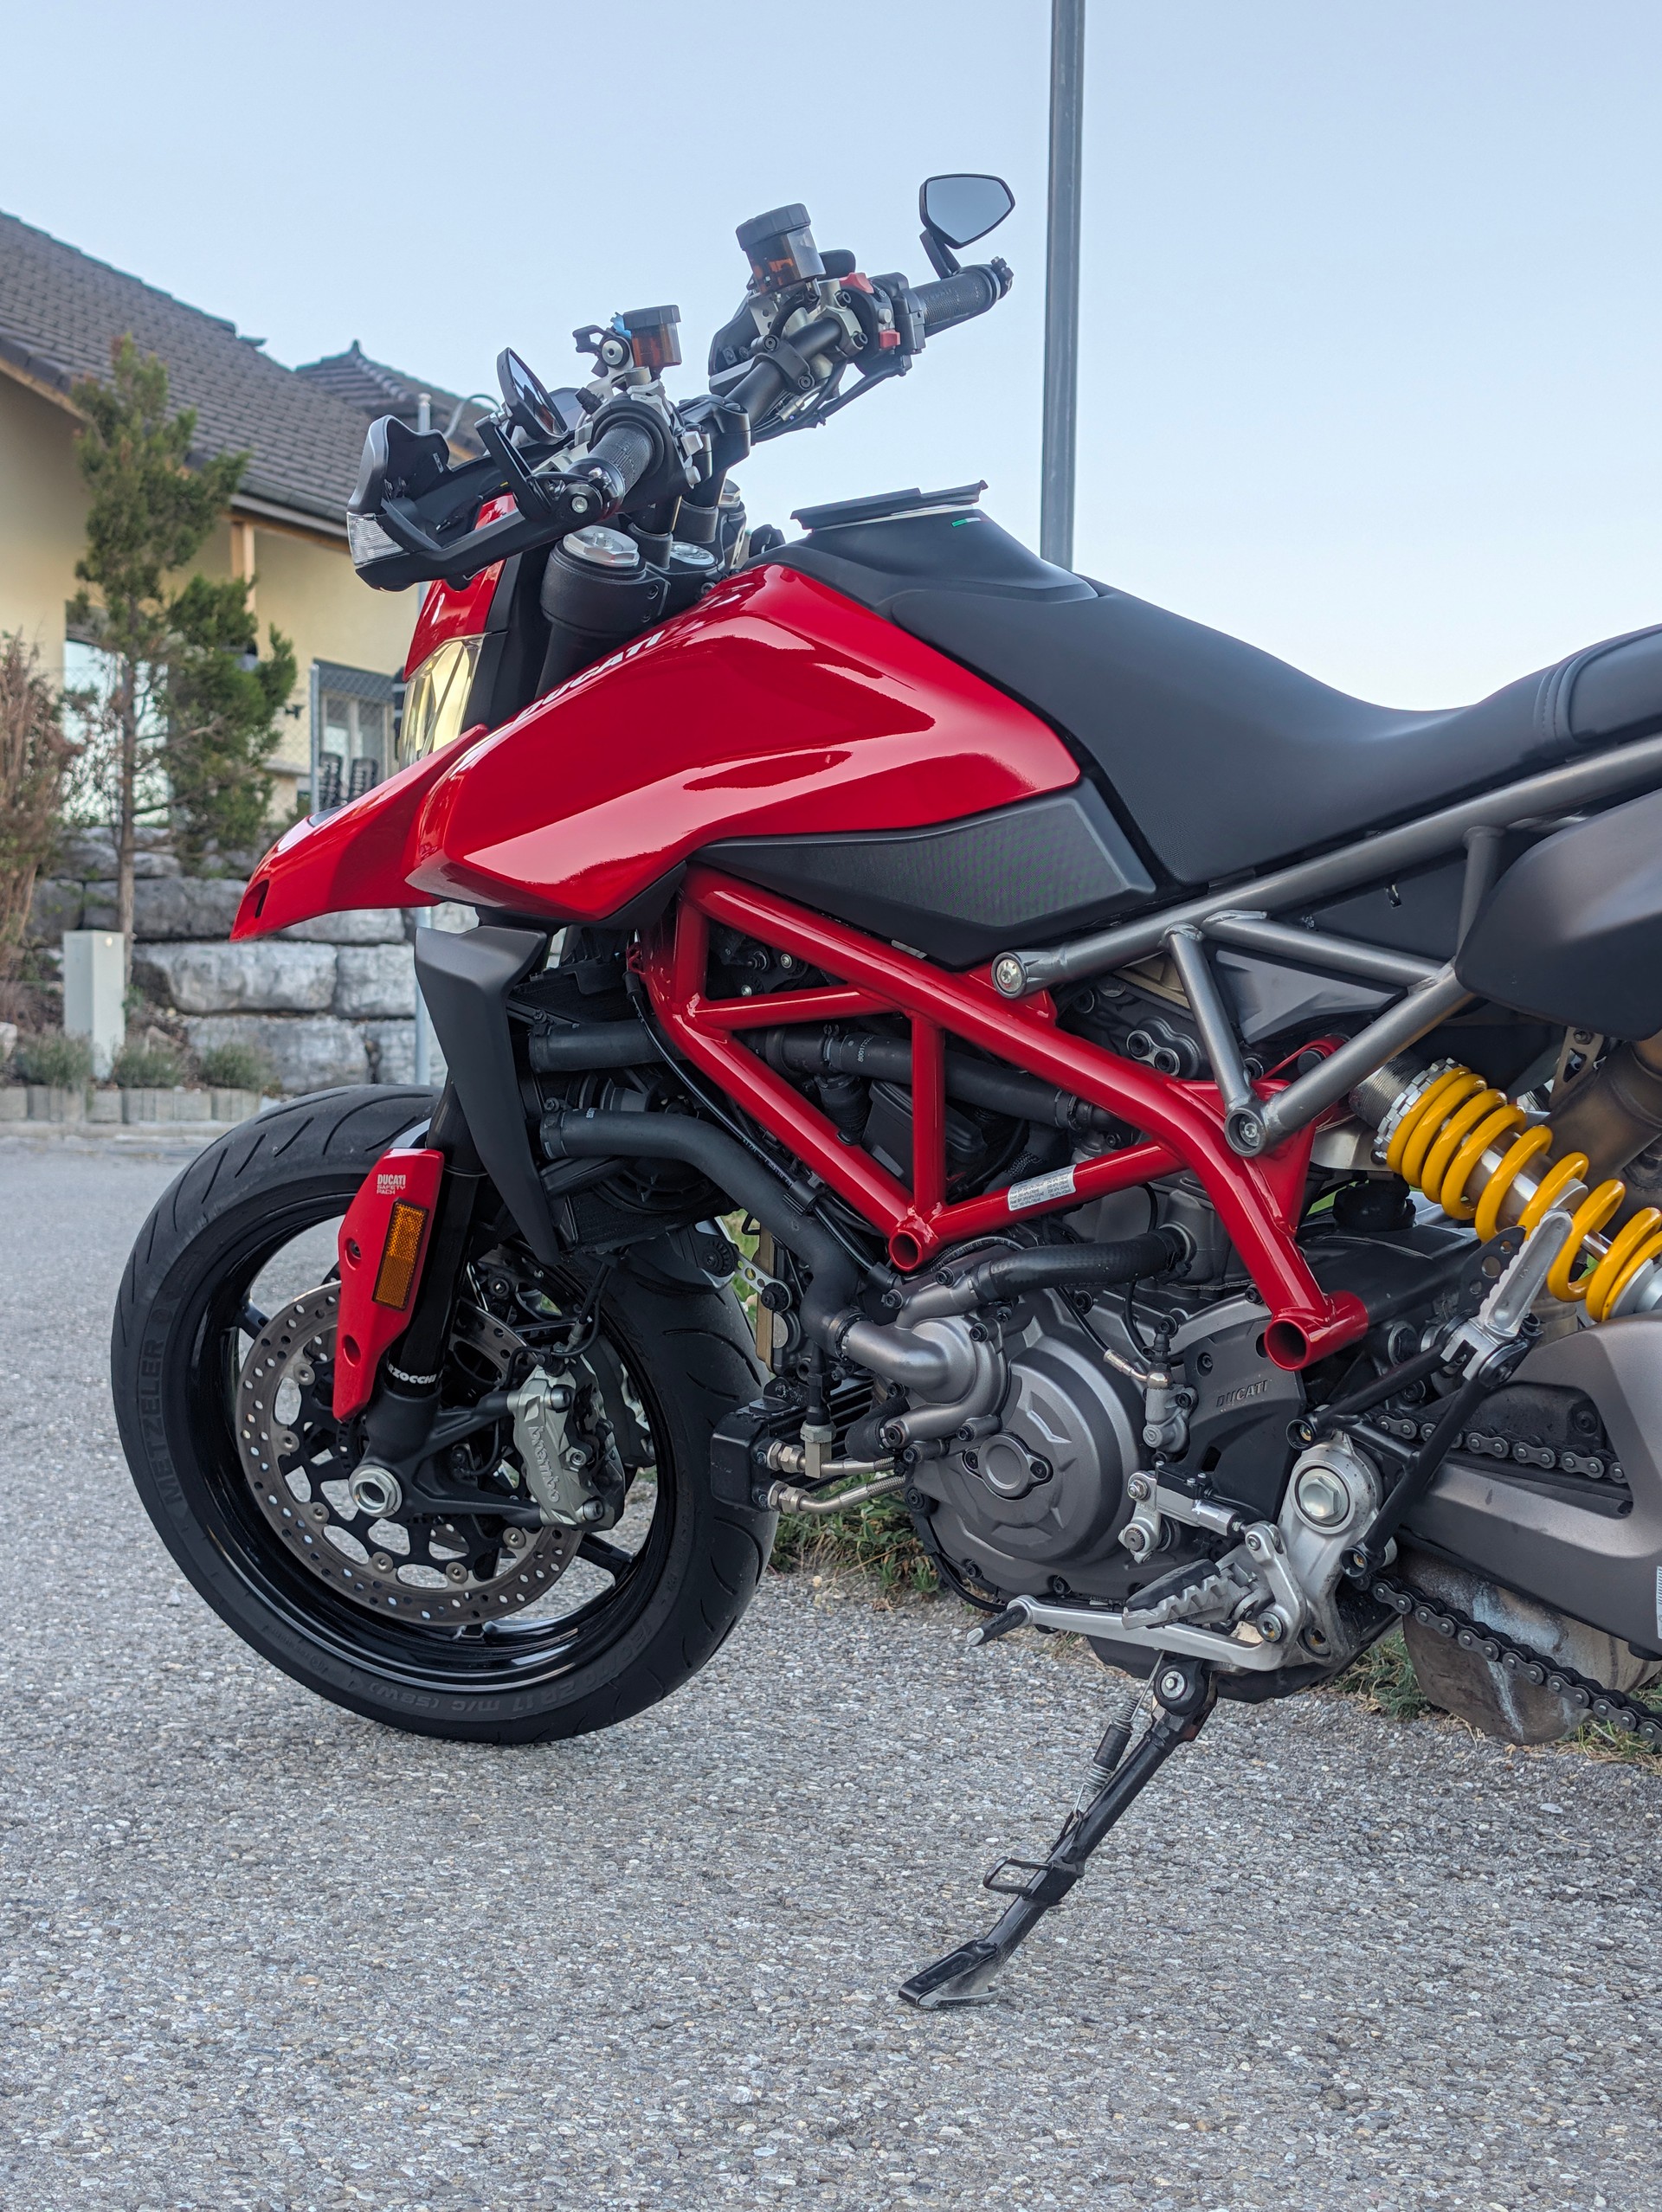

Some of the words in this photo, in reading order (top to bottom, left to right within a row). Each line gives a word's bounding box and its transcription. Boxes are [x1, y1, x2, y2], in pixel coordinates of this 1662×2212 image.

[514, 630, 666, 723] DUCATI
[377, 1174, 406, 1186] DUCATI
[139, 1339, 184, 1506] METZELER
[1216, 1379, 1268, 1408] DUCATI
[527, 1425, 560, 1502] brembo
